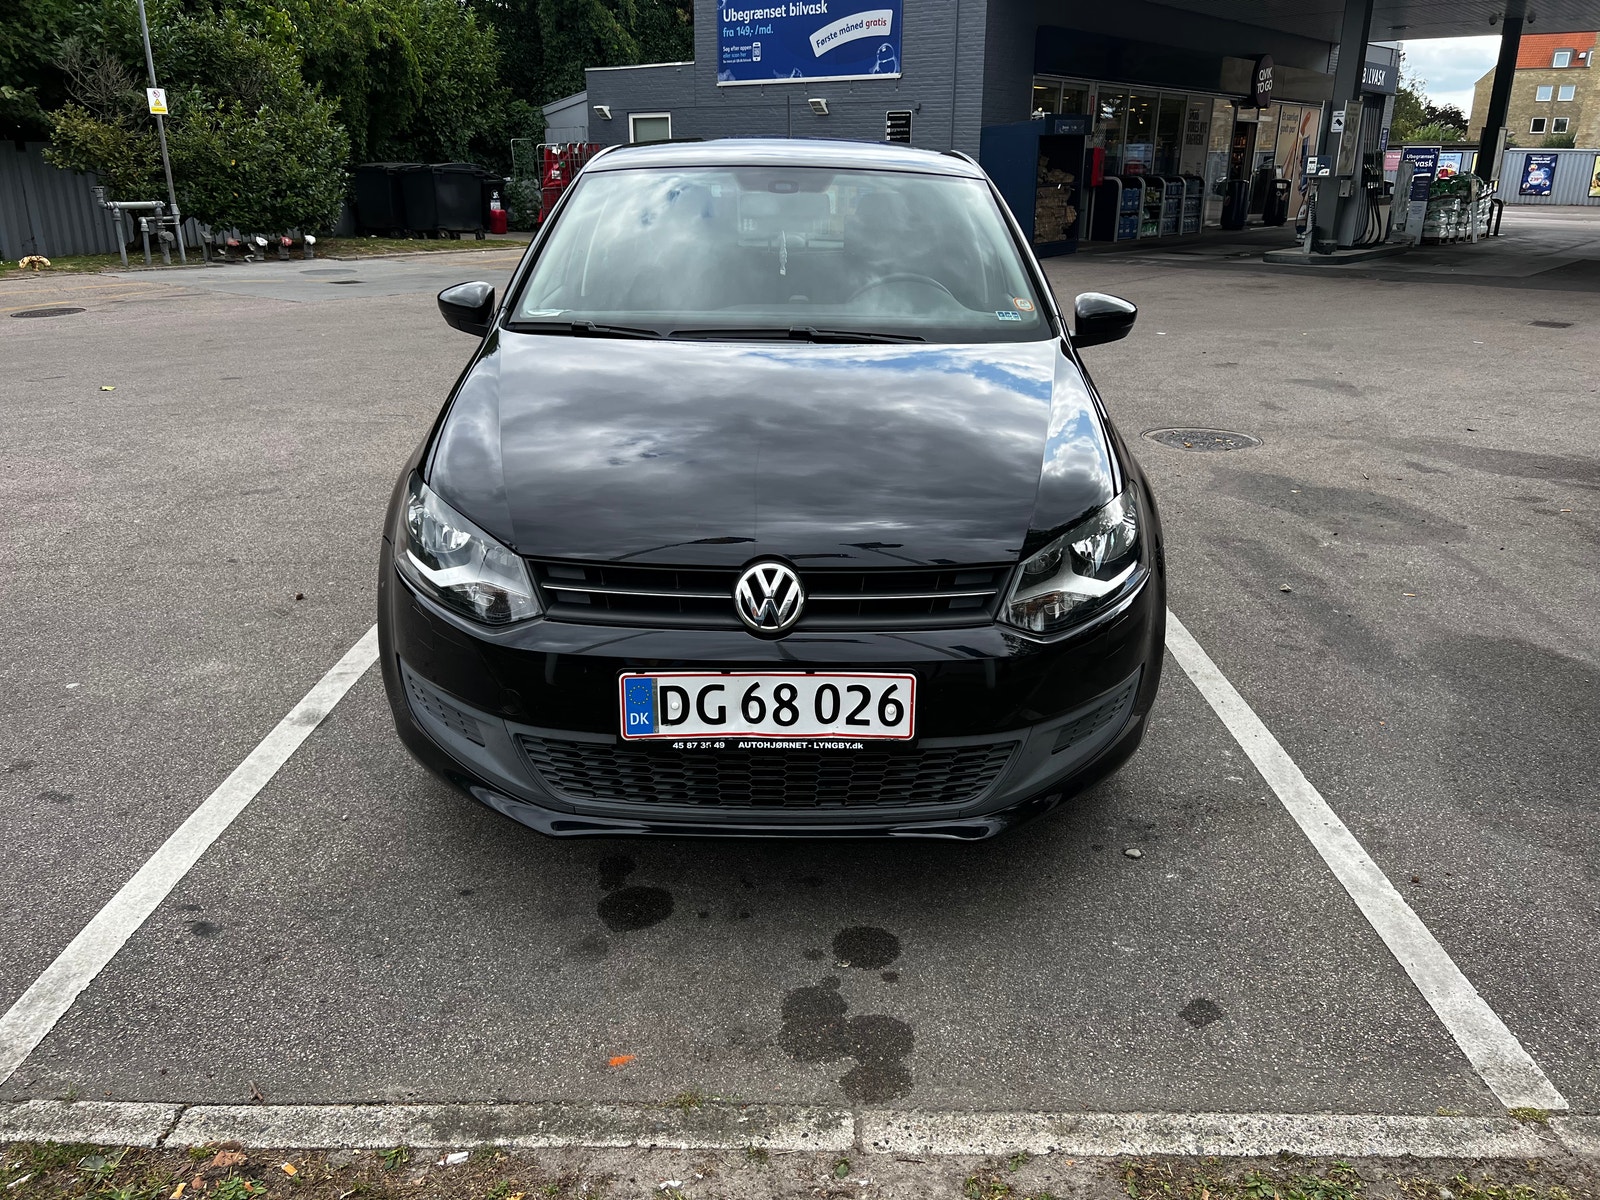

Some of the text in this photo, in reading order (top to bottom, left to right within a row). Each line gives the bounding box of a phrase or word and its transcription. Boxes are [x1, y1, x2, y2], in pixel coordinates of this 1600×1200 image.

[723, 0, 828, 24] Ubegrænset bilvask
[723, 27, 735, 37] fra
[816, 18, 887, 48] Første måned gratis
[1257, 80, 1273, 94] TO GO
[659, 681, 905, 727] DG 68 026
[630, 712, 649, 725] DK
